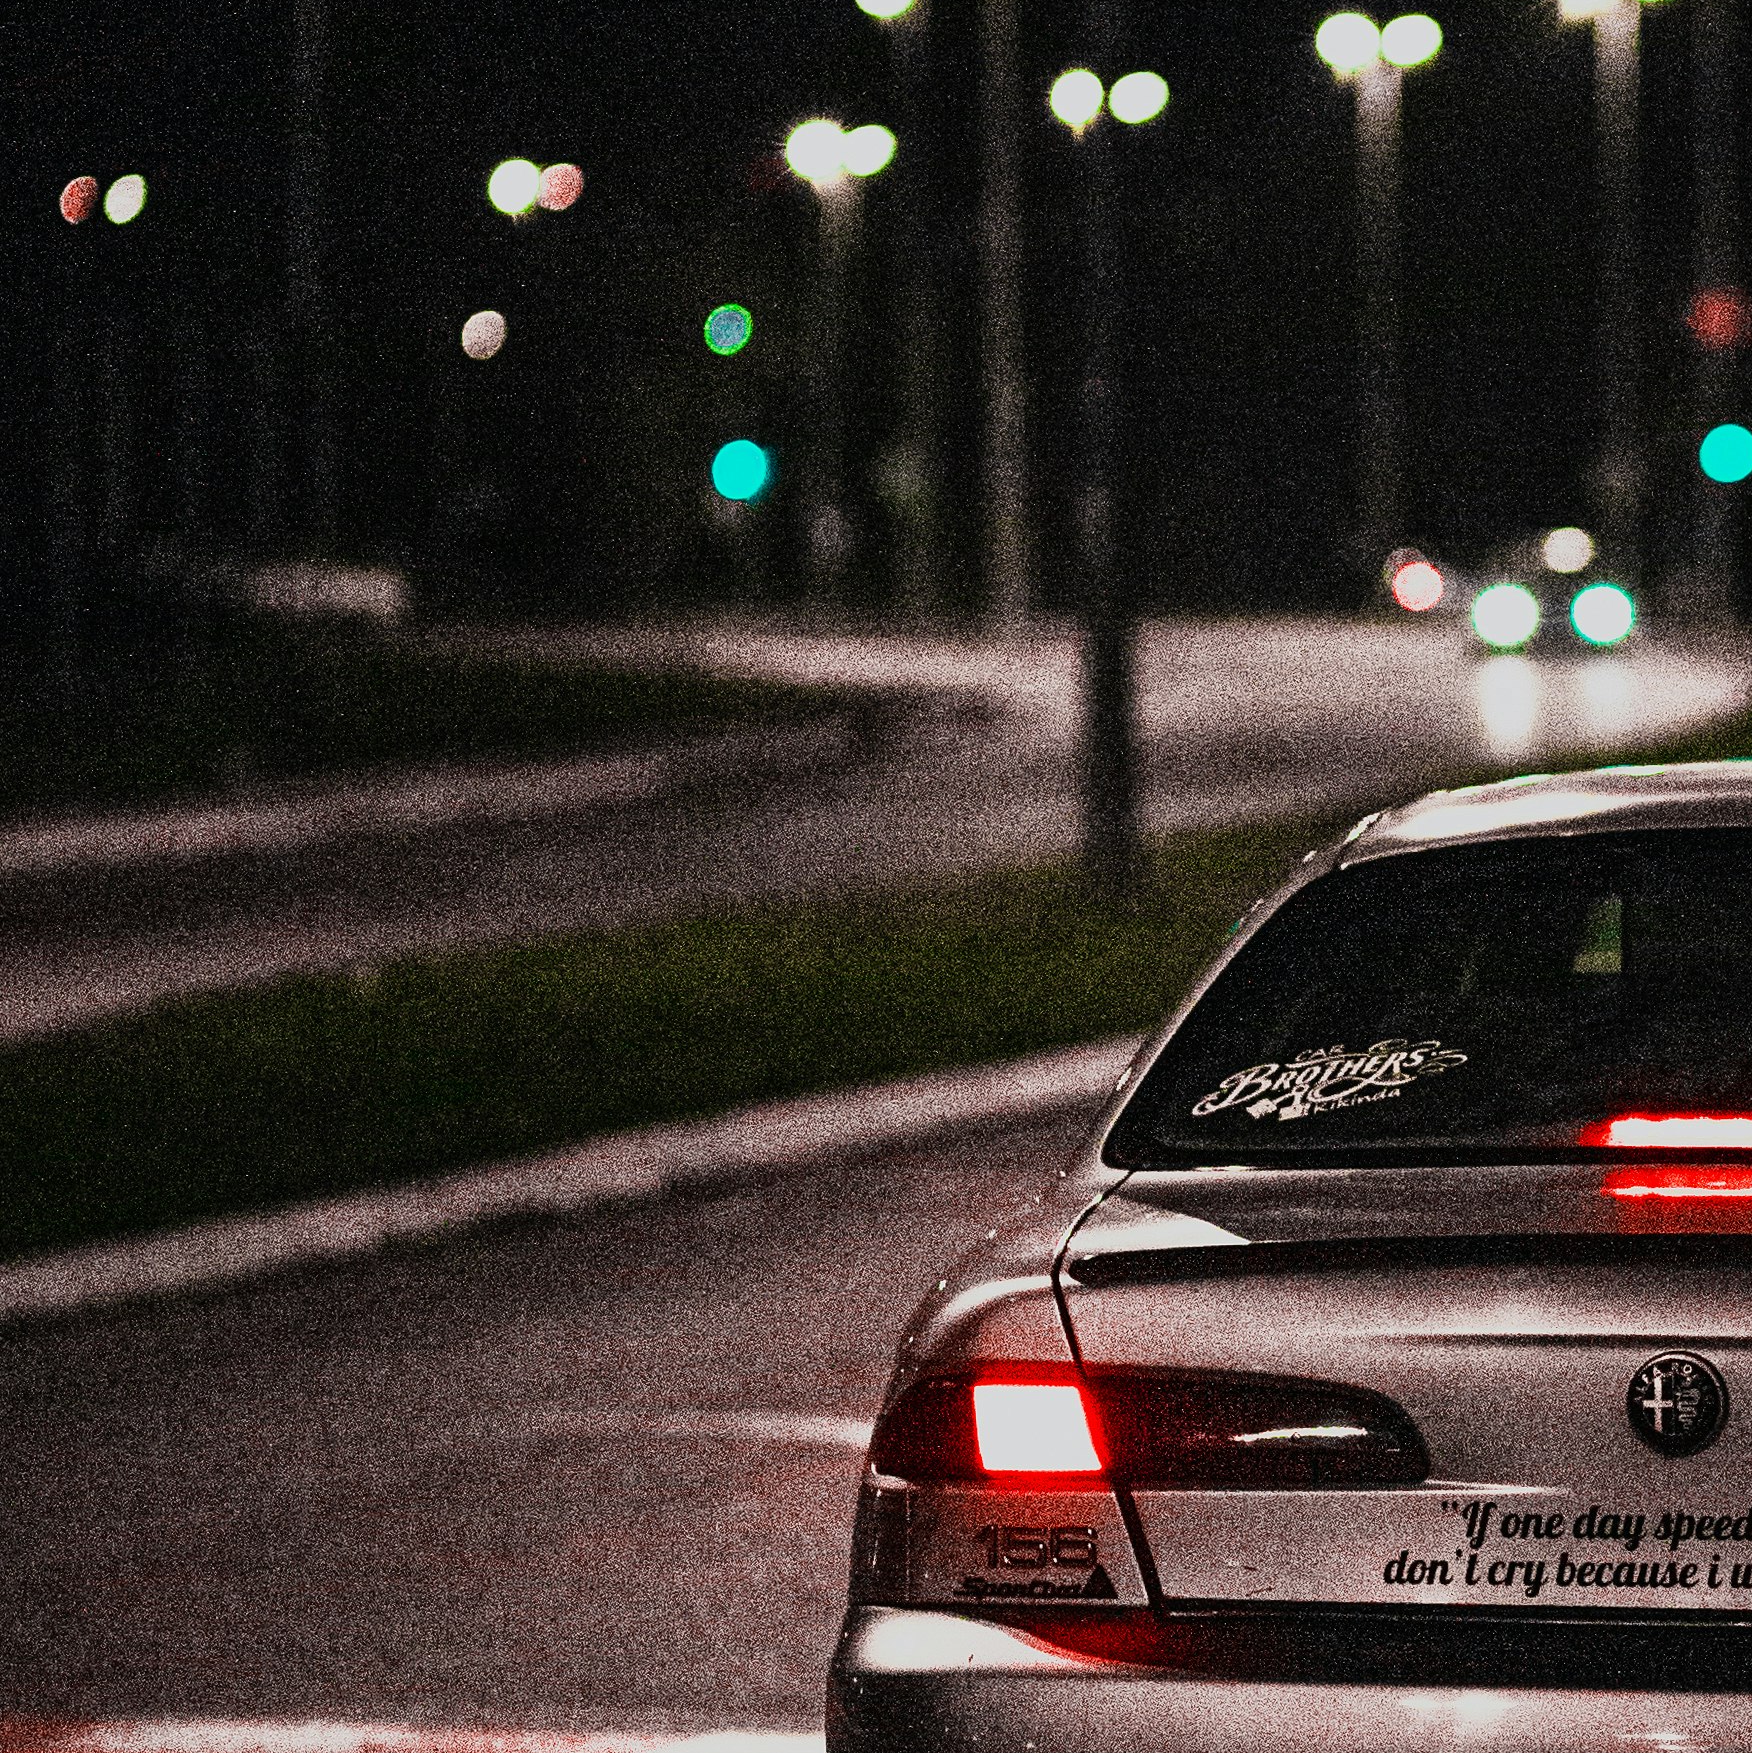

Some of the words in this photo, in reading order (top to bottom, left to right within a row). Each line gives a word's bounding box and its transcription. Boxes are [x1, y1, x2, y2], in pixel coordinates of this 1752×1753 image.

[1295, 1044, 1346, 1062] CAR
[975, 1525, 1098, 1569] 156
[1502, 1512, 1565, 1539] one
[1572, 1505, 1646, 1551] day
[1383, 1549, 1480, 1586] don't
[1487, 1560, 1548, 1598] cry
[1556, 1552, 1698, 1588] because
[1707, 1553, 1723, 1589] i
